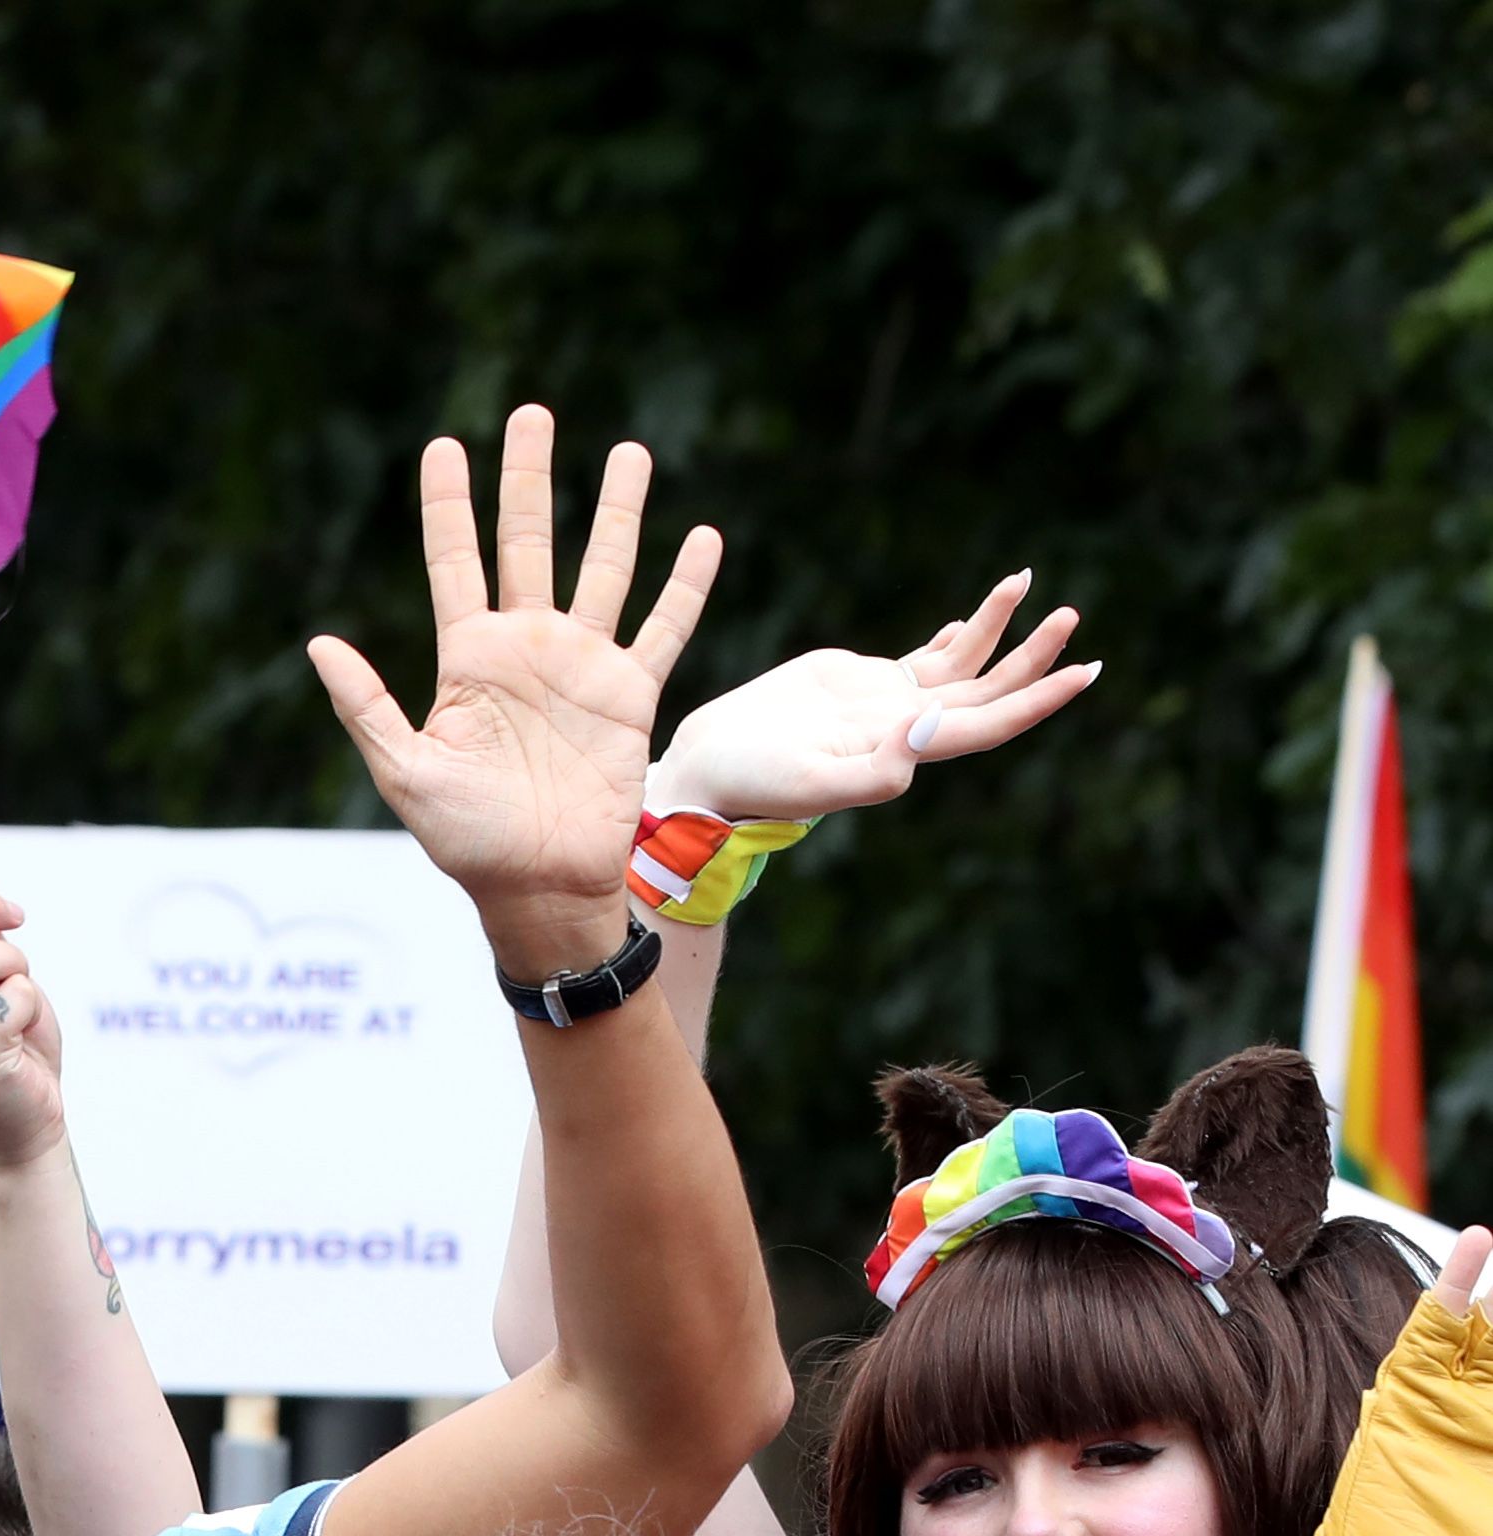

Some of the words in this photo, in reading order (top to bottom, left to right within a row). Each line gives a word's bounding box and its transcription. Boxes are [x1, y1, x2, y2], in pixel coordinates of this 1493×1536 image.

[151, 960, 253, 992] YOU
[267, 960, 360, 992] ARE
[92, 1004, 342, 1036] WELCOME
[360, 1004, 416, 1036] AT
[103, 1221, 459, 1276] orrymeela
